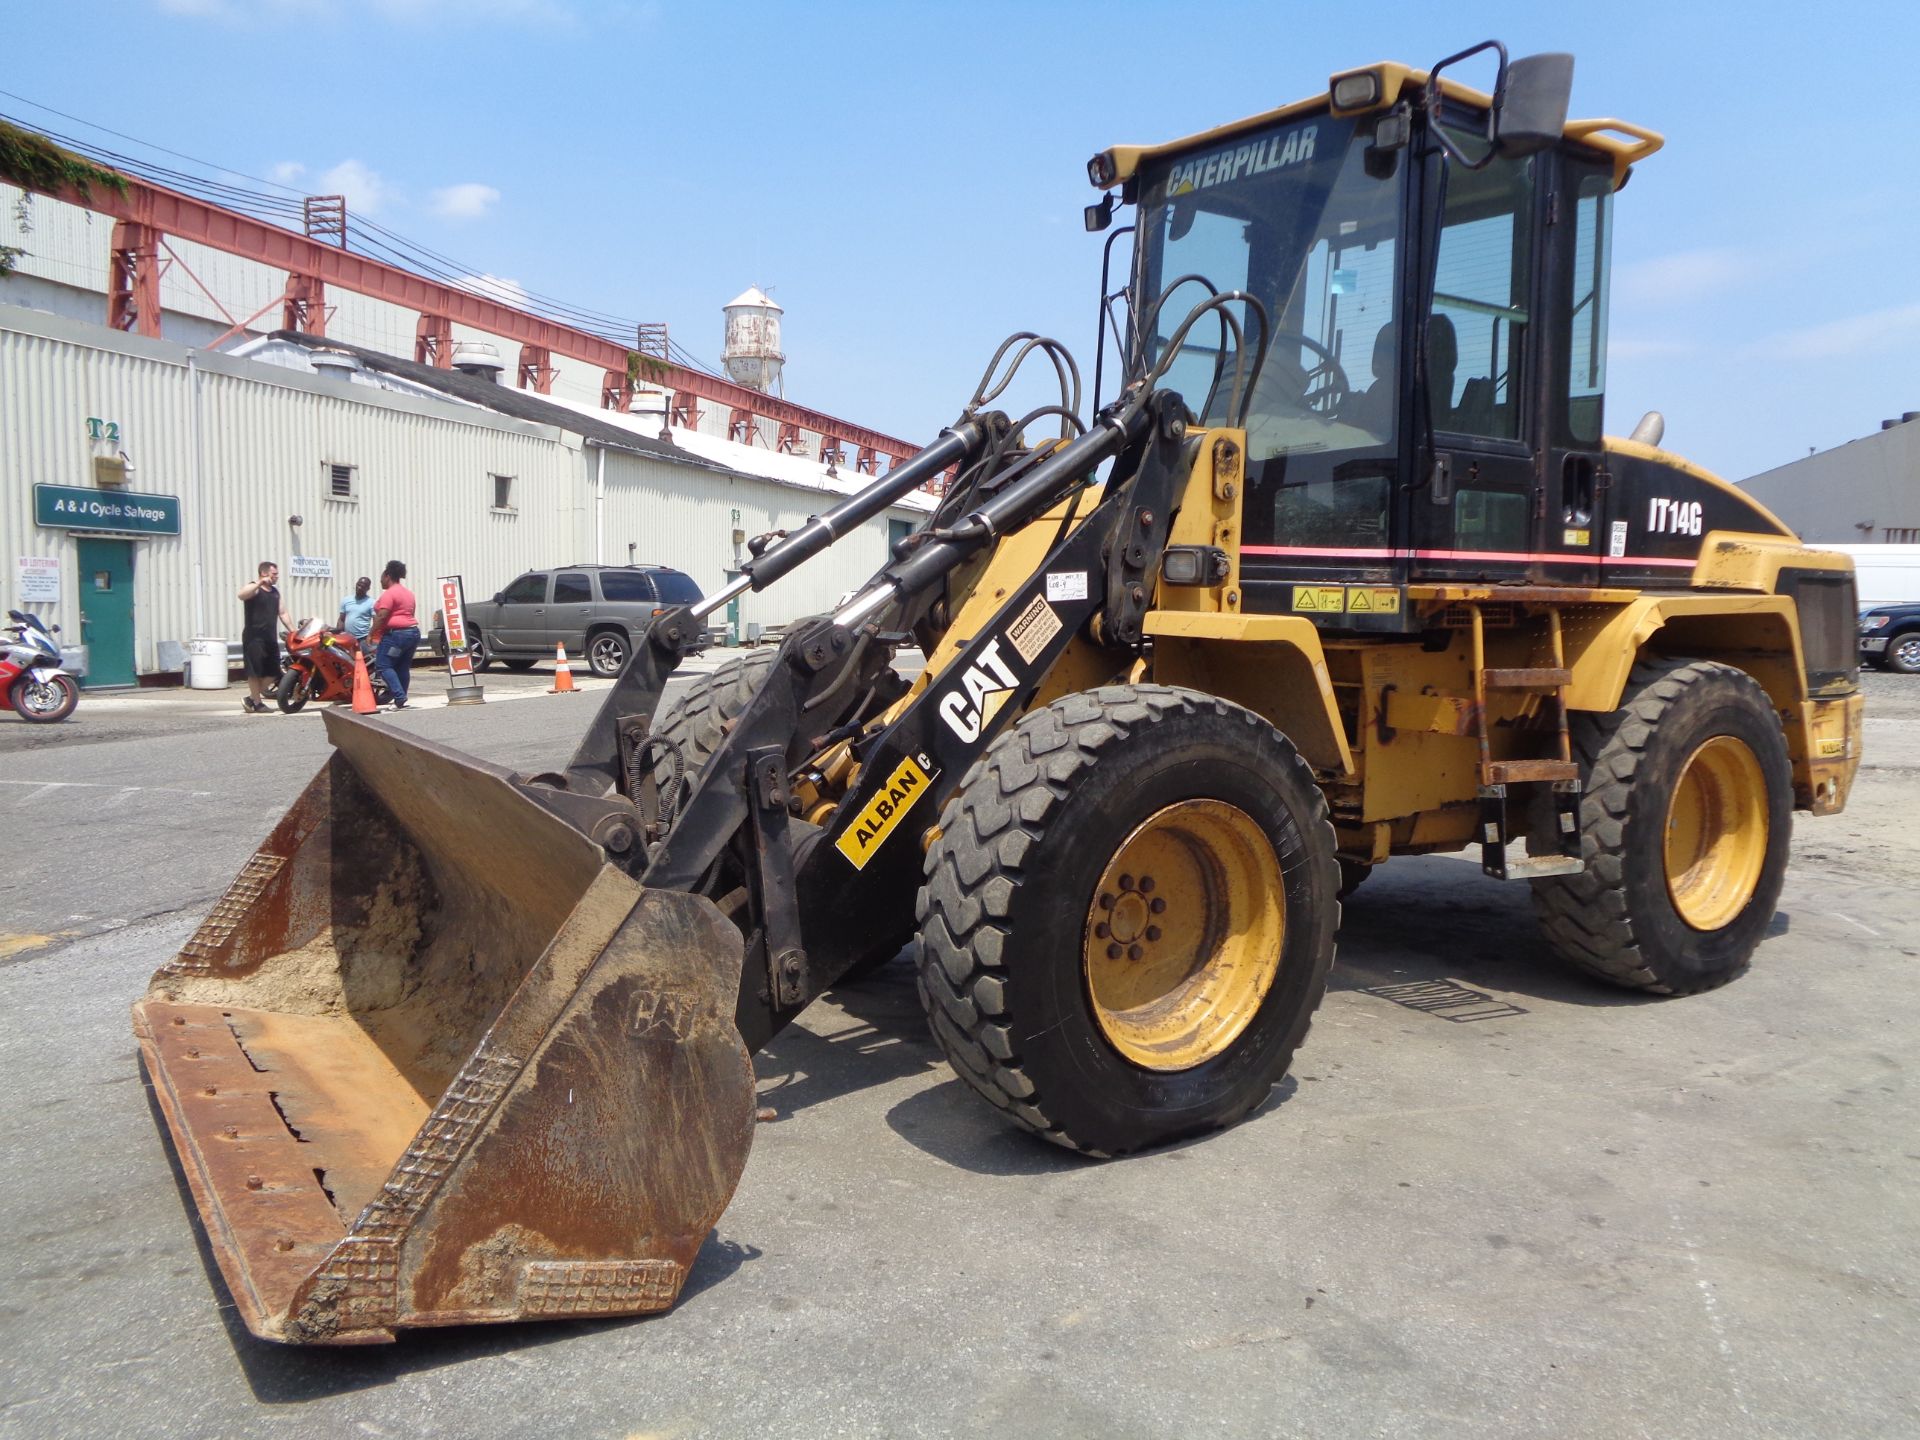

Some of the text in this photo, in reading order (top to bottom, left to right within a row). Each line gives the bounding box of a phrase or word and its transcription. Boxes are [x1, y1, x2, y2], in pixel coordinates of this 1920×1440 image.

[1165, 125, 1319, 198] CATERPILLAR
[87, 417, 119, 441] T2
[54, 499, 165, 521] A & J Cycle Salvage
[1647, 497, 1703, 536] IT14G
[443, 583, 463, 640] OPEN
[1011, 600, 1044, 639] WARNING
[939, 637, 1020, 744] CAT
[855, 770, 918, 849] ALBAN
